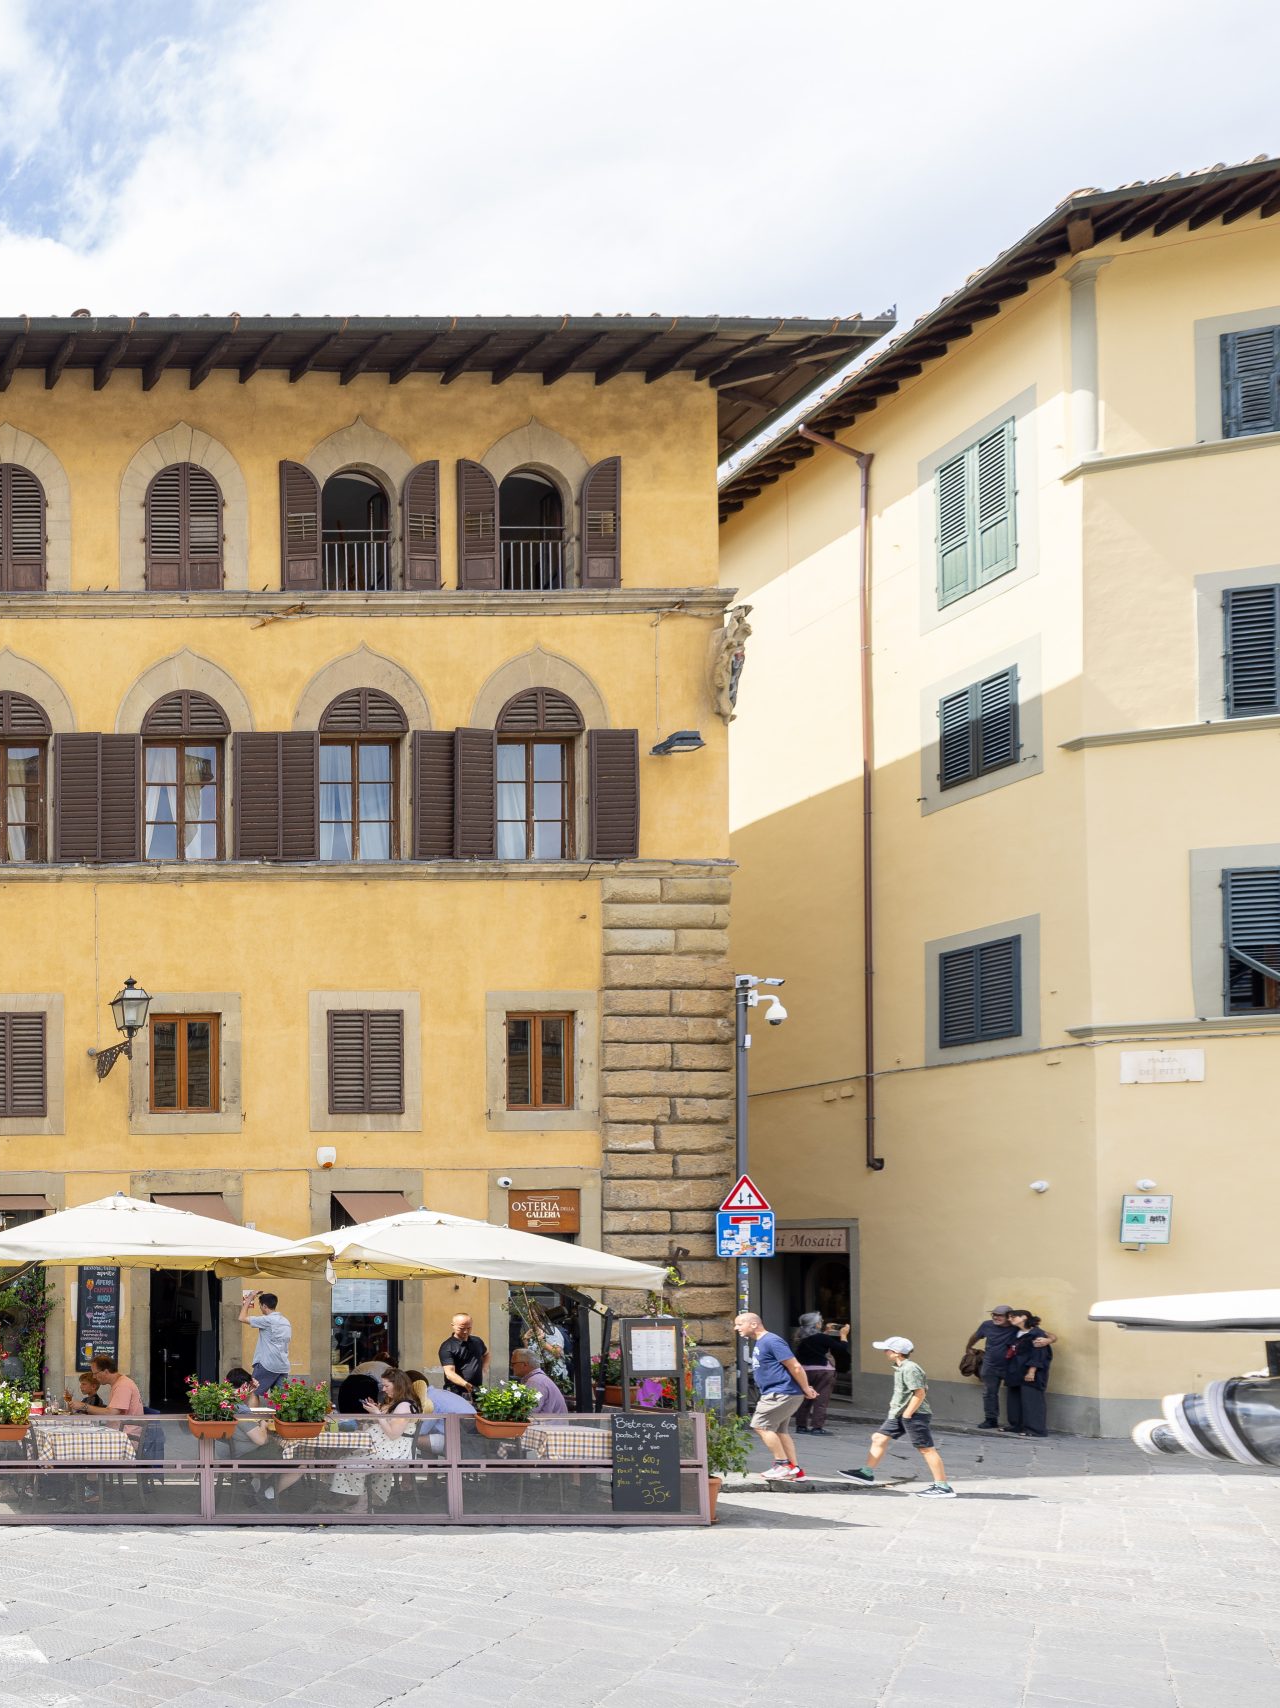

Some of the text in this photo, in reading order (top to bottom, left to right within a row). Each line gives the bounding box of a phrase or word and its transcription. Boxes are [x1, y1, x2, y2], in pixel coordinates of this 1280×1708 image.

[511, 1201, 559, 1212] OSTERIA
[526, 1211, 561, 1219] GALLERIA
[790, 1233, 842, 1247] Mosaici
